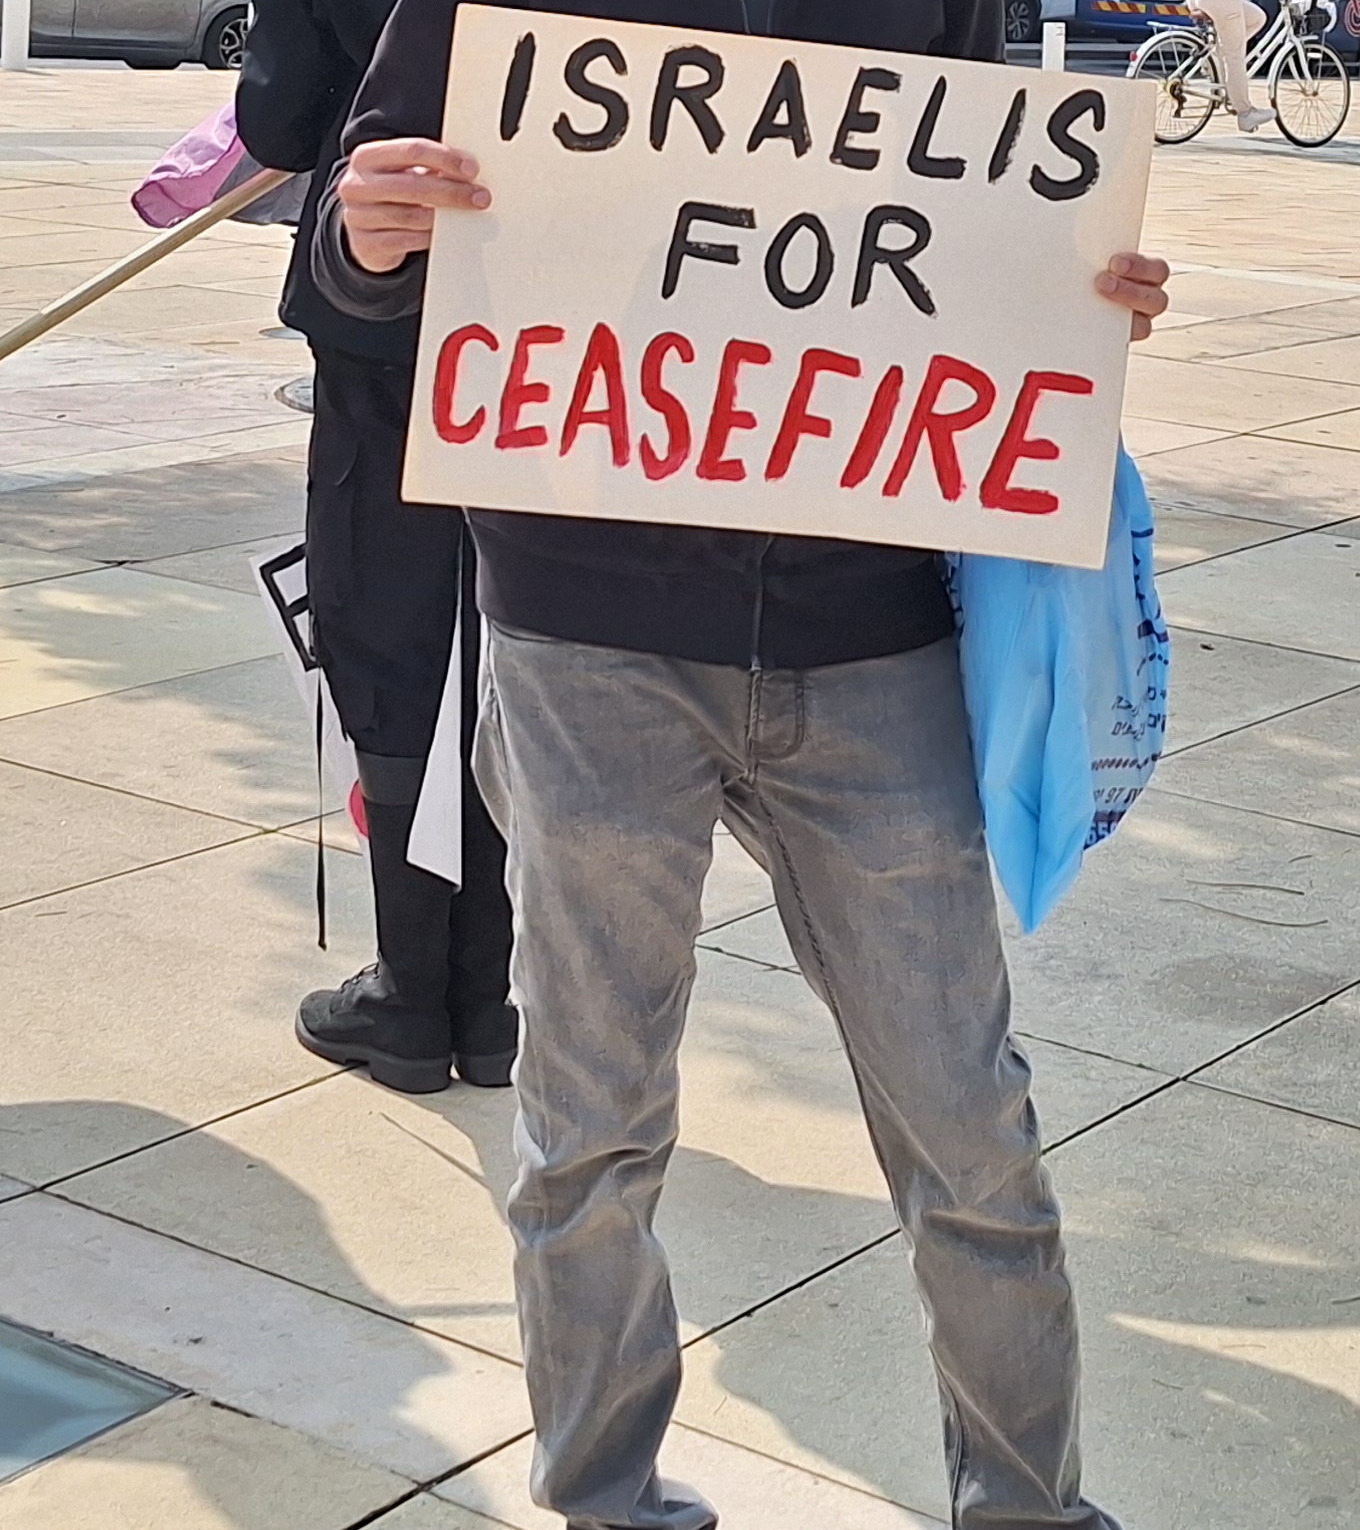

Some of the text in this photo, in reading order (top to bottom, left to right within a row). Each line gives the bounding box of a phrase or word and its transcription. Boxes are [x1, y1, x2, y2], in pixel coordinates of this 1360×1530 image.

[500, 32, 1106, 201] ISRAELIS
[661, 202, 937, 318] FOR
[432, 323, 1095, 515] CEASEFIRE
